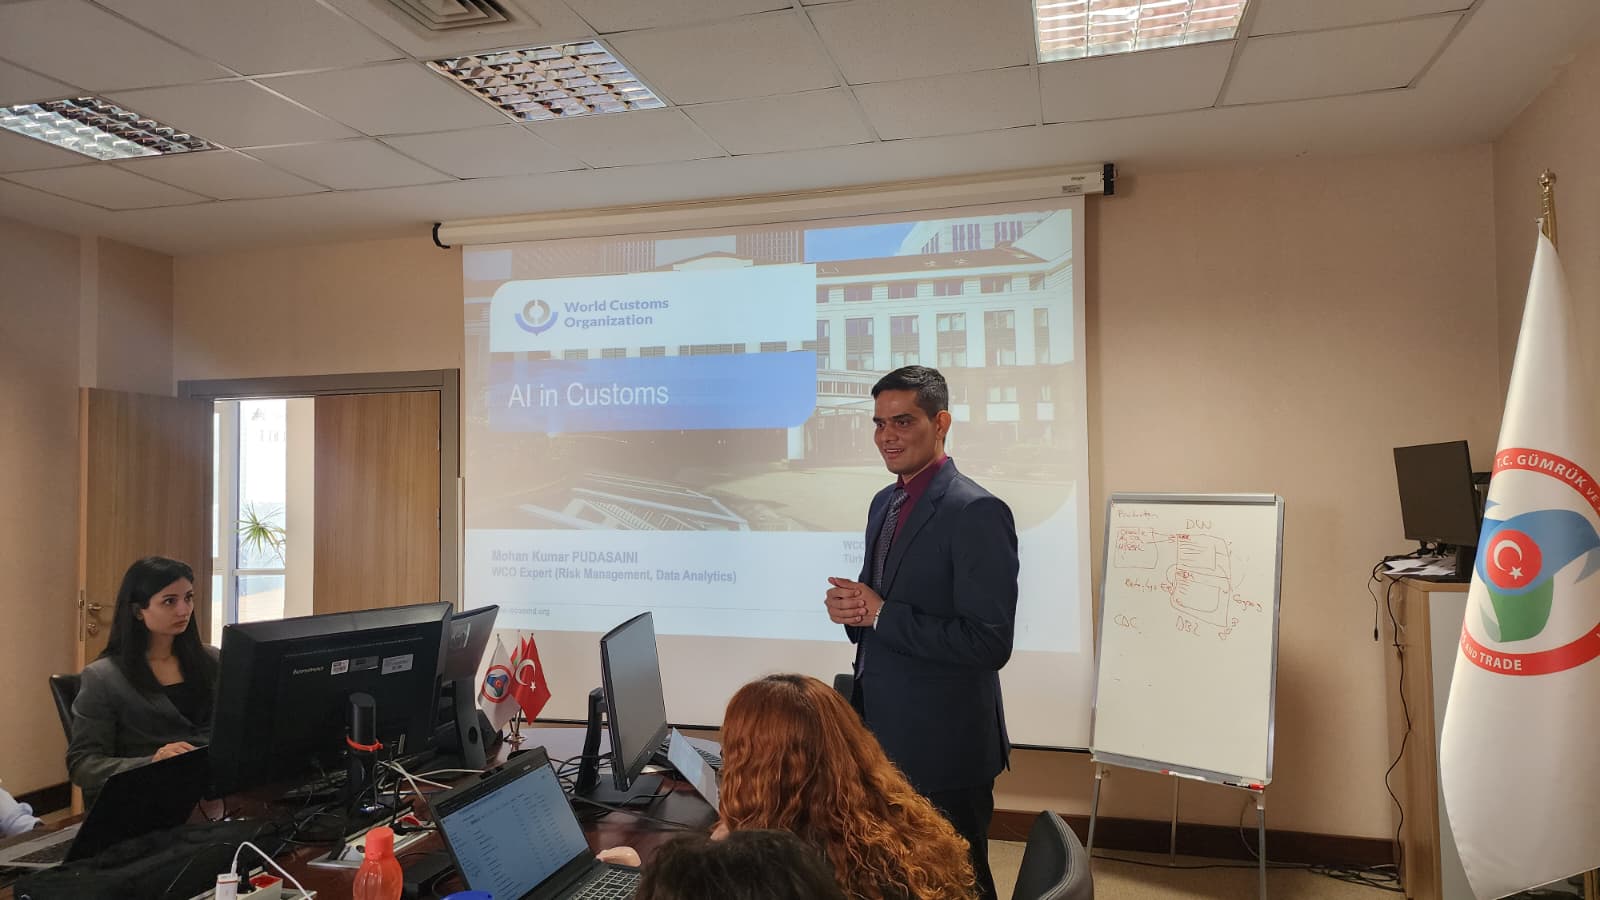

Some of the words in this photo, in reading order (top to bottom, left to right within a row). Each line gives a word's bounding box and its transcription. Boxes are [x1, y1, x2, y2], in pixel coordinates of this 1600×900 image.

[564, 300, 606, 313] World
[609, 299, 669, 311] Customs
[564, 314, 653, 329] Organization
[508, 383, 531, 408] AI
[539, 383, 558, 407] in
[566, 382, 670, 407] Customs
[1517, 453, 1586, 488] GÜMRÜK
[1586, 487, 1600, 503] VE
[491, 550, 529, 562] Mohan
[532, 551, 569, 563] Kumar
[572, 551, 639, 564] PUDASAINI
[491, 566, 517, 577] WCO
[519, 567, 552, 580] Expert
[555, 567, 581, 581] (Risk
[583, 569, 653, 582] Management,
[656, 570, 680, 581] Data
[682, 570, 737, 584] Analytics)
[1479, 652, 1522, 671] TRADE
